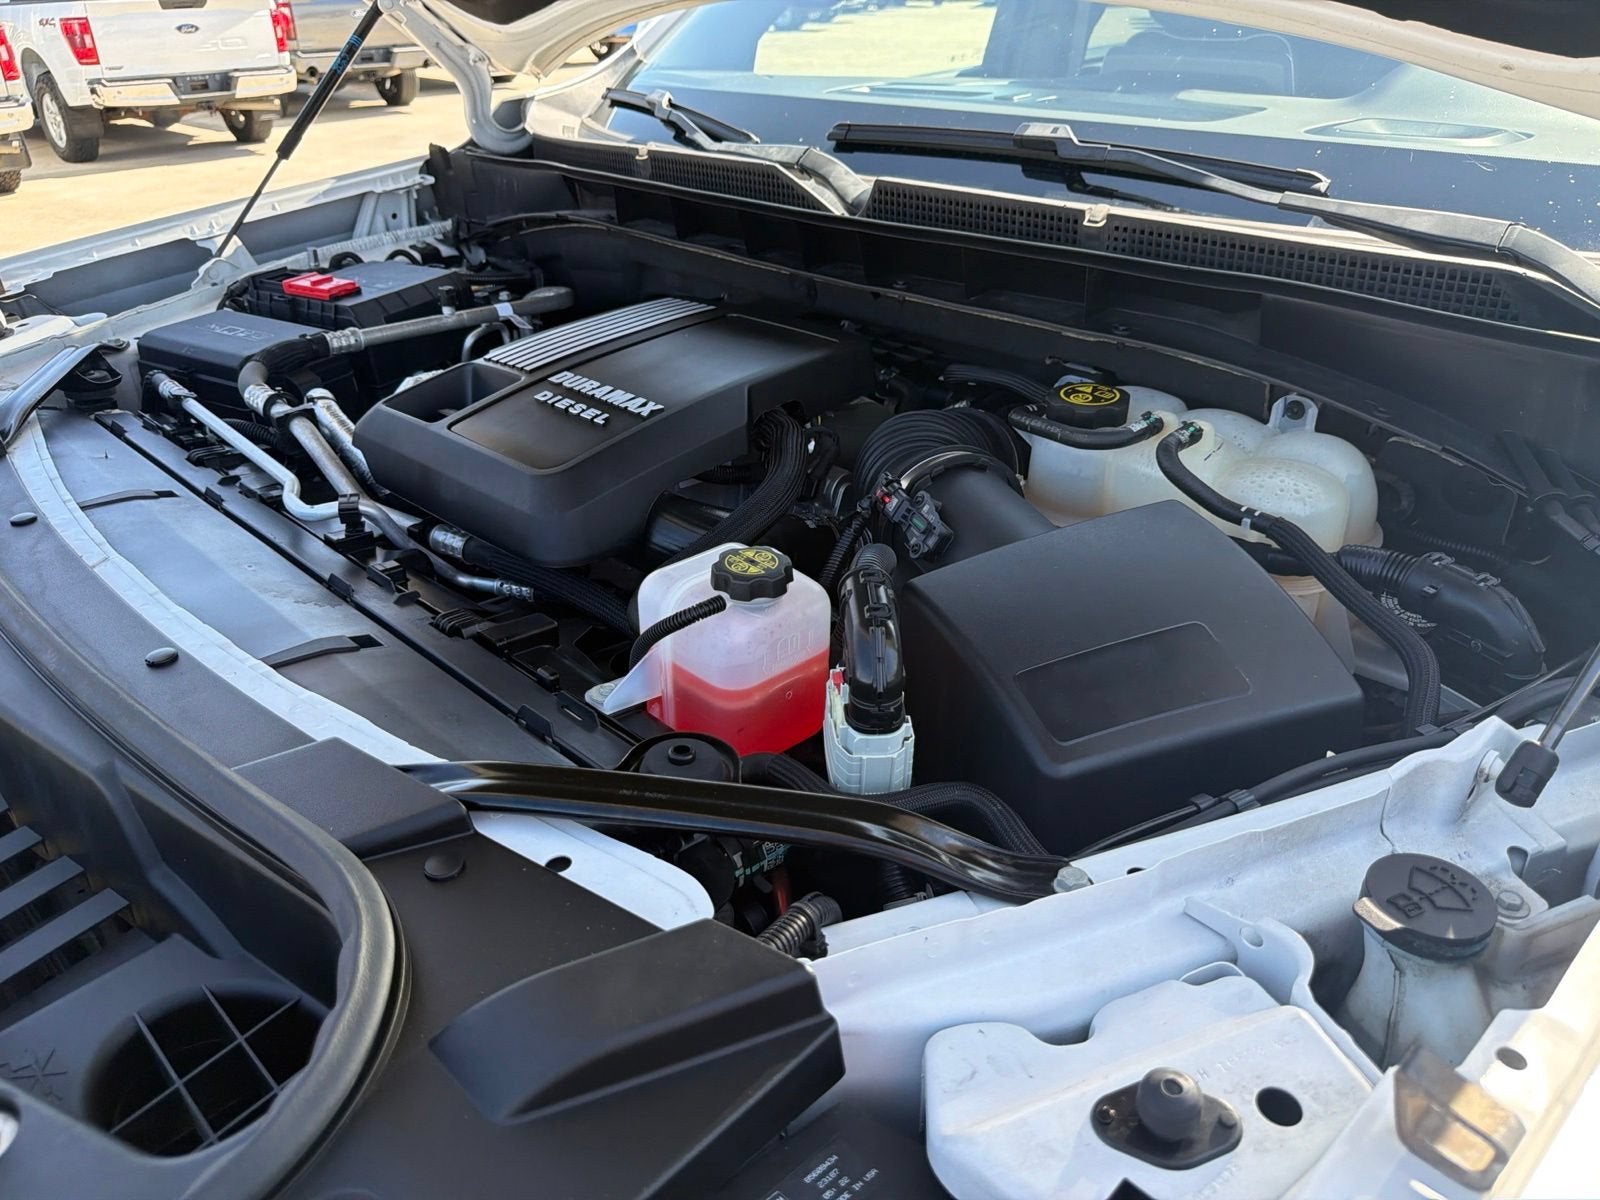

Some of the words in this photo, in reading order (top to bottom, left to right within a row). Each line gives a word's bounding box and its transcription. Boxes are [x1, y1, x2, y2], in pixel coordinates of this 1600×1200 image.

[533, 390, 610, 425] DIESEL
[548, 370, 665, 417] DURAMAX
[851, 1180, 864, 1190] IN
[863, 1168, 879, 1181] USA
